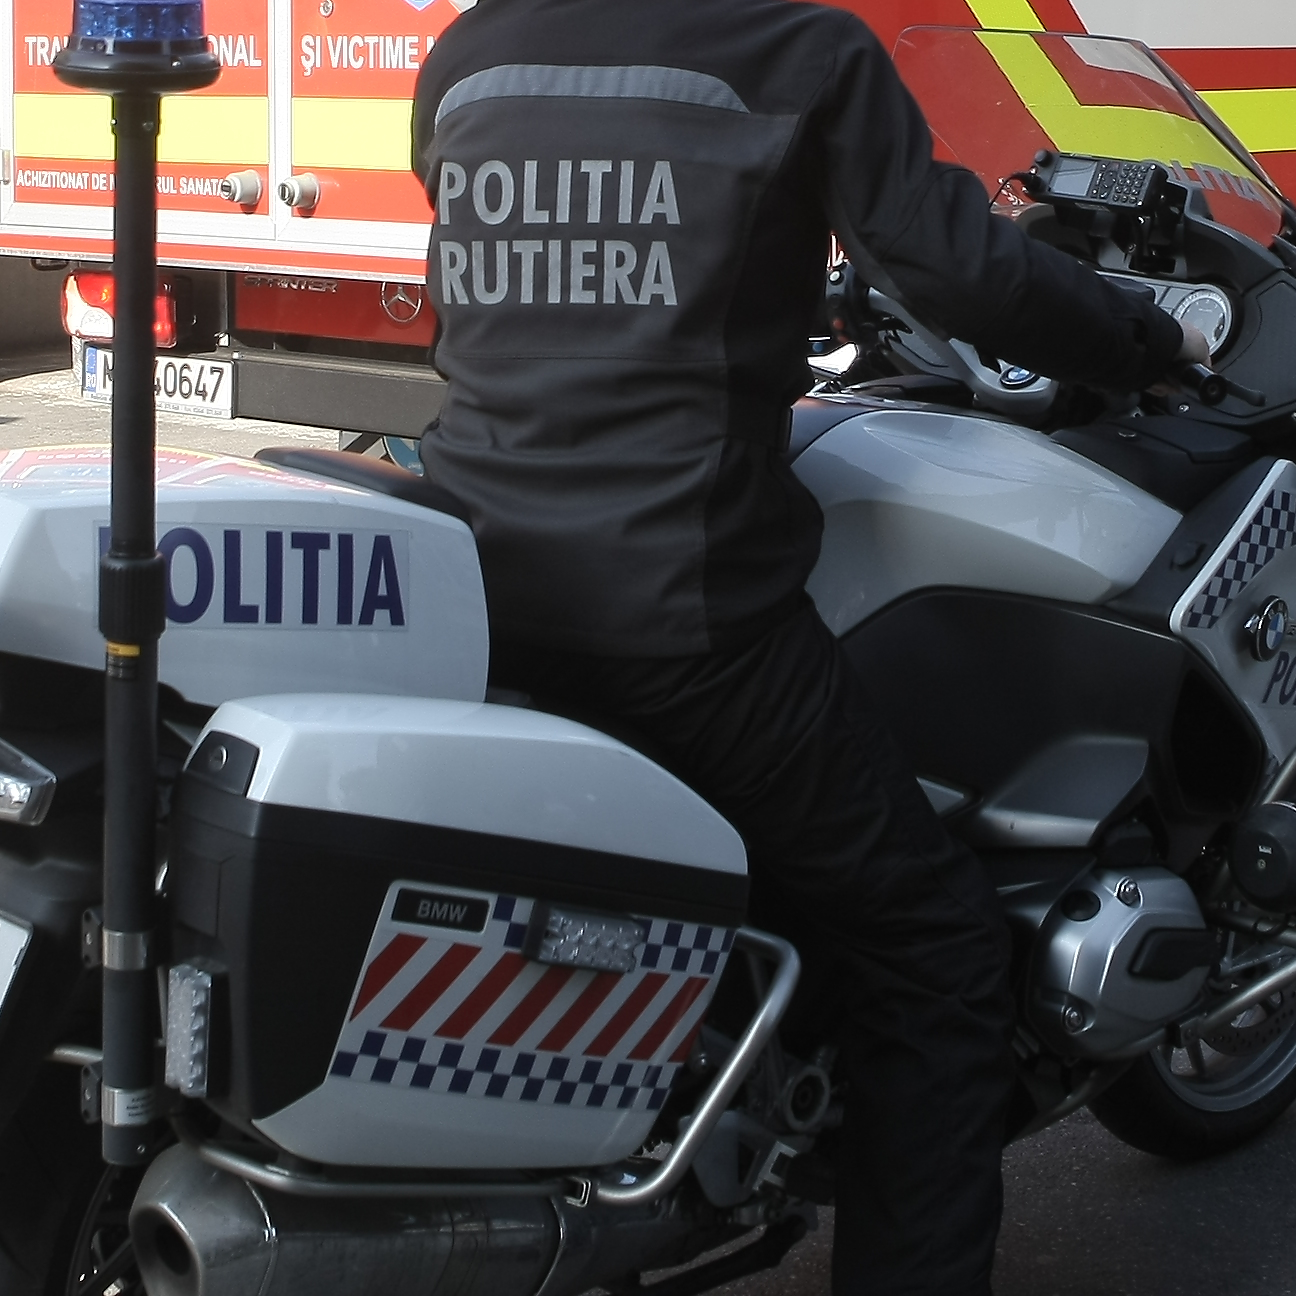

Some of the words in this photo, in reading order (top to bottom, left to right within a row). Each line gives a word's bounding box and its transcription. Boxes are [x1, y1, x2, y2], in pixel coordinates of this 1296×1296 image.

[328, 36, 421, 70] VICTIME
[16, 169, 90, 190] ACHIZITIONAT
[91, 173, 107, 191] DE
[439, 160, 681, 225] POLITIA
[439, 240, 679, 305] RUTIERA
[99, 525, 405, 626] OLITIA
[417, 899, 469, 923] BMW
